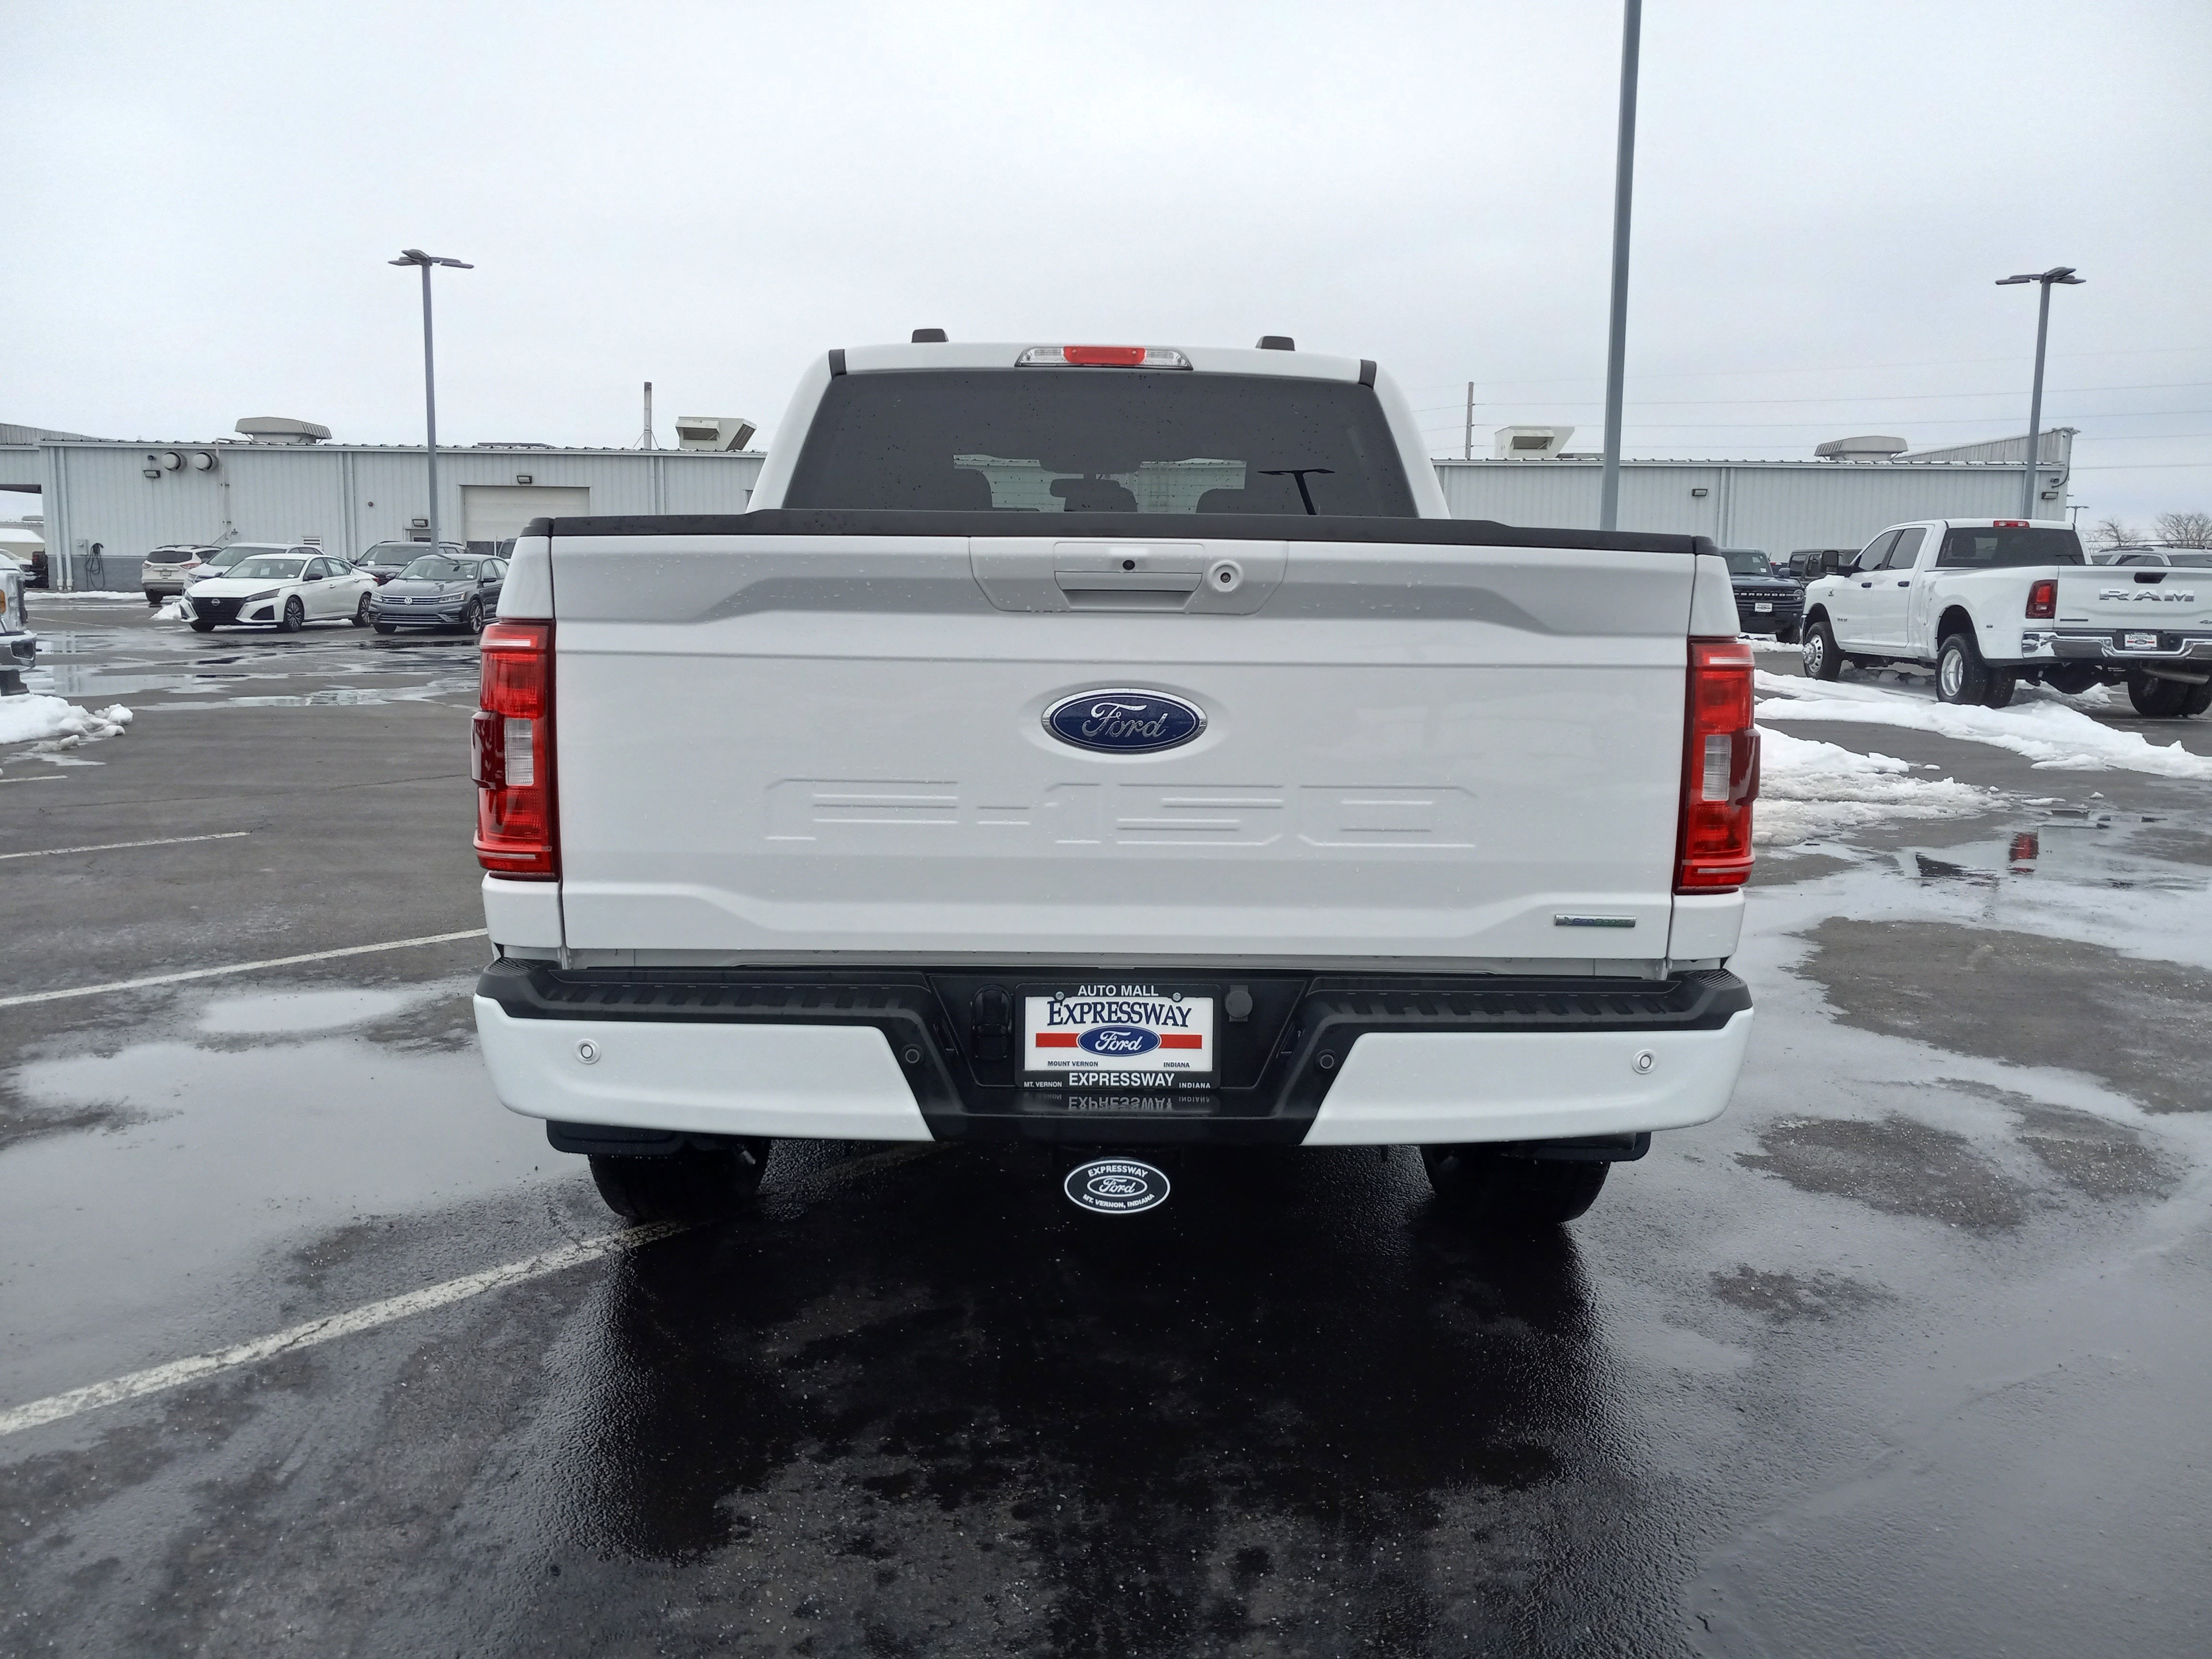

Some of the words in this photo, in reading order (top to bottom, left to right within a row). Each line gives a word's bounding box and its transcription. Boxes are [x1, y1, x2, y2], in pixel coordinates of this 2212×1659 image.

[2099, 589, 2194, 602] RAM
[1082, 702, 1168, 737] Ford
[763, 777, 1479, 849] F-150
[1078, 985, 1117, 997] AUTO
[1121, 985, 1159, 996] MALL
[1047, 1000, 1192, 1028] EXPRESSWAY
[1095, 1031, 1142, 1051] Ford
[1069, 1072, 1175, 1087] EXPRESSWAY
[1087, 1165, 1149, 1178] EXPRESSWAY
[1099, 1178, 1136, 1193] Ford
[1082, 1194, 1094, 1203] MT.
[1095, 1199, 1126, 1209] VERNON,
[1127, 1193, 1155, 1207] INDIANA
